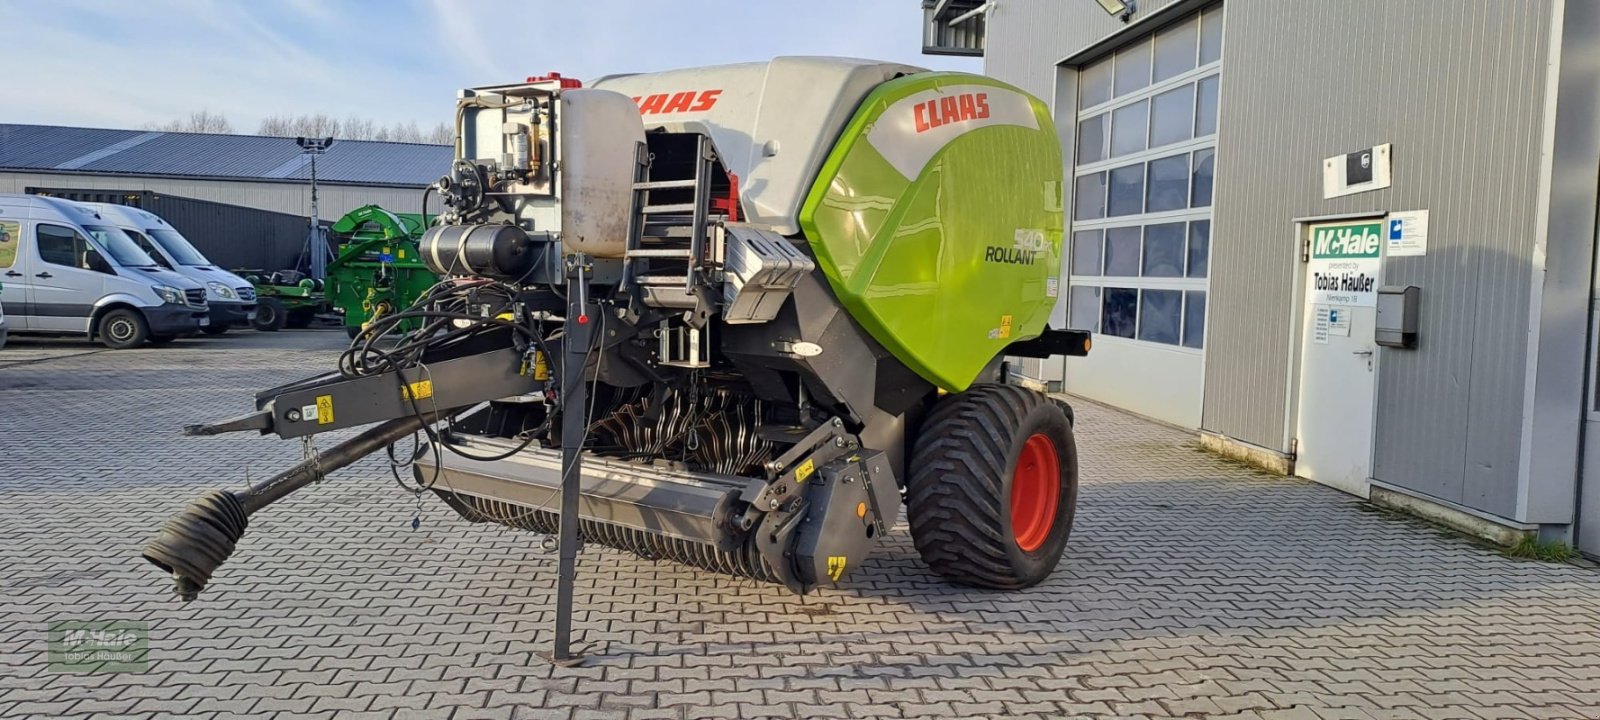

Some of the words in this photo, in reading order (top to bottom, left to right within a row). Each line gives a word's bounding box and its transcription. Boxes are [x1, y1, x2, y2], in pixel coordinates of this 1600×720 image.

[632, 90, 723, 114] AAS
[913, 93, 990, 133] CLAAS
[1315, 228, 1379, 255] McHale
[985, 246, 1037, 265] ROLLANT
[1314, 272, 1339, 291] Tobias
[1341, 271, 1375, 292] Häußer
